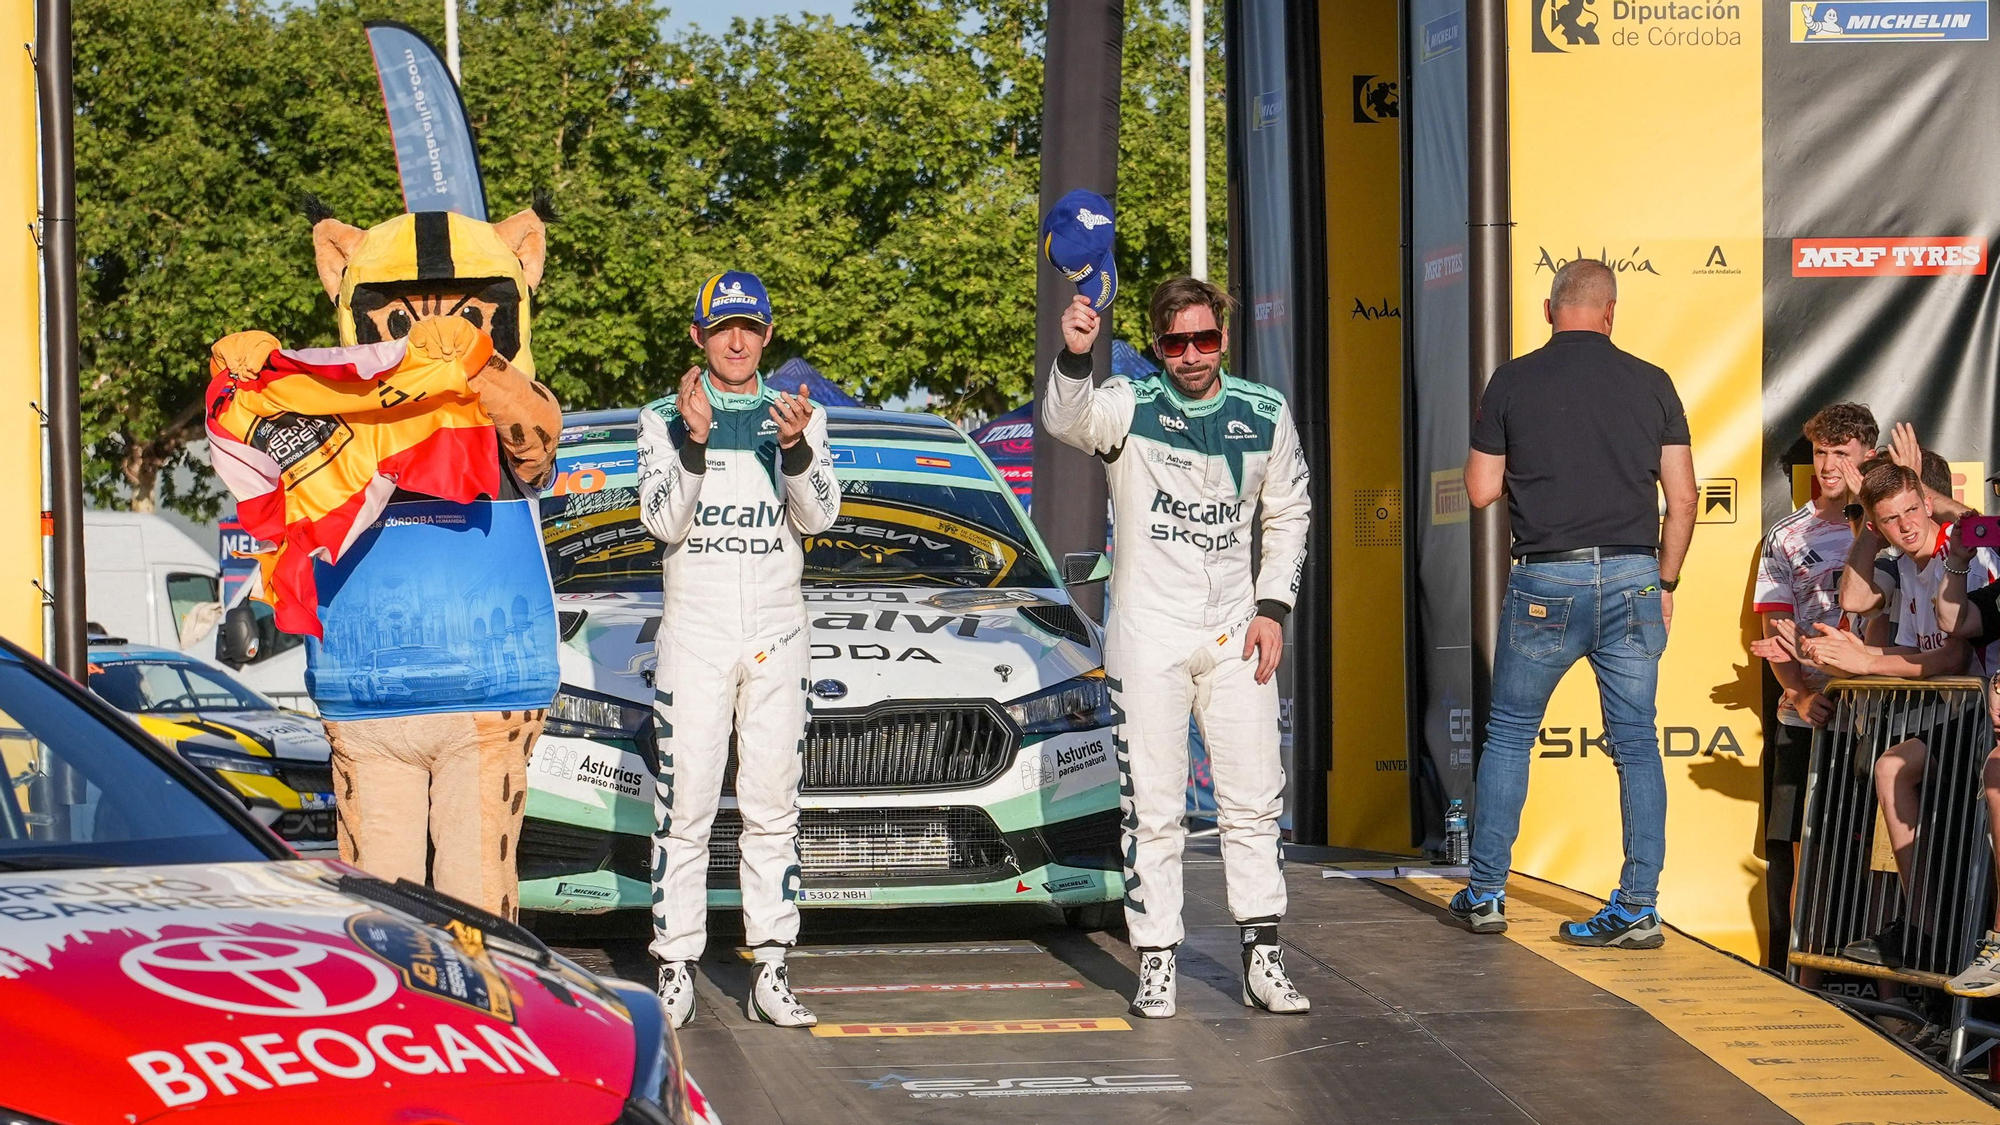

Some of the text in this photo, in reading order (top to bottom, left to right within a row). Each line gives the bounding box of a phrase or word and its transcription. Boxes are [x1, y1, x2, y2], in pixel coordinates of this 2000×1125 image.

[1612, 0, 1740, 21] Diputación
[1846, 13, 1971, 30] MICHELIN
[1612, 26, 1741, 46] de Córdoba
[1798, 245, 1981, 268] MRF TYRES
[712, 297, 758, 308] MICHELIN
[687, 537, 784, 554] SKODA
[1151, 524, 1240, 552] SKODA
[1538, 727, 1745, 758] SKDA
[1057, 738, 1104, 766] Asturias
[580, 754, 643, 786] Asturias
[1084, 754, 1108, 771] natural
[609, 781, 641, 797] natural
[573, 887, 612, 898] MICHELIN
[1058, 879, 1090, 889] MICHELIN
[809, 889, 867, 900] 5302 NBH
[840, 1018, 1100, 1034] PIRELLI
[126, 1023, 560, 1107] BREOGAN
